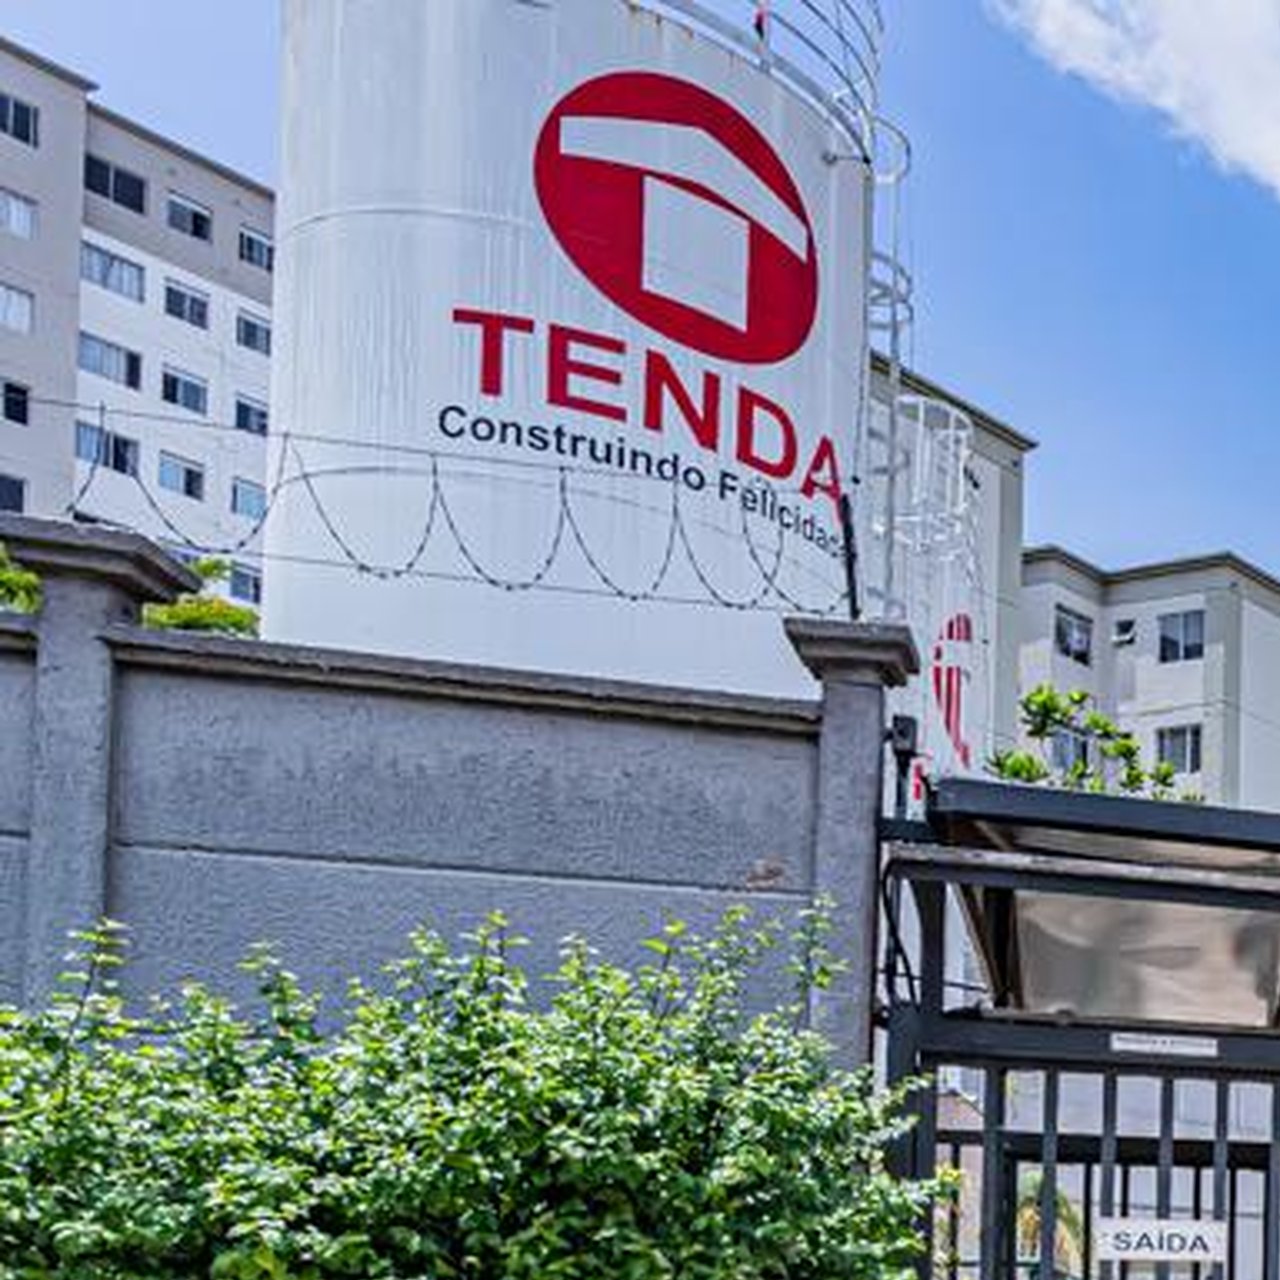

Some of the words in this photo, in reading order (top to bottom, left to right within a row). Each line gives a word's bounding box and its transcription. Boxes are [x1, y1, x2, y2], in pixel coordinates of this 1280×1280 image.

[438, 405, 706, 491] Construindo
[452, 308, 843, 526] TENDA
[1112, 1227, 1212, 1253] SAÍDA
